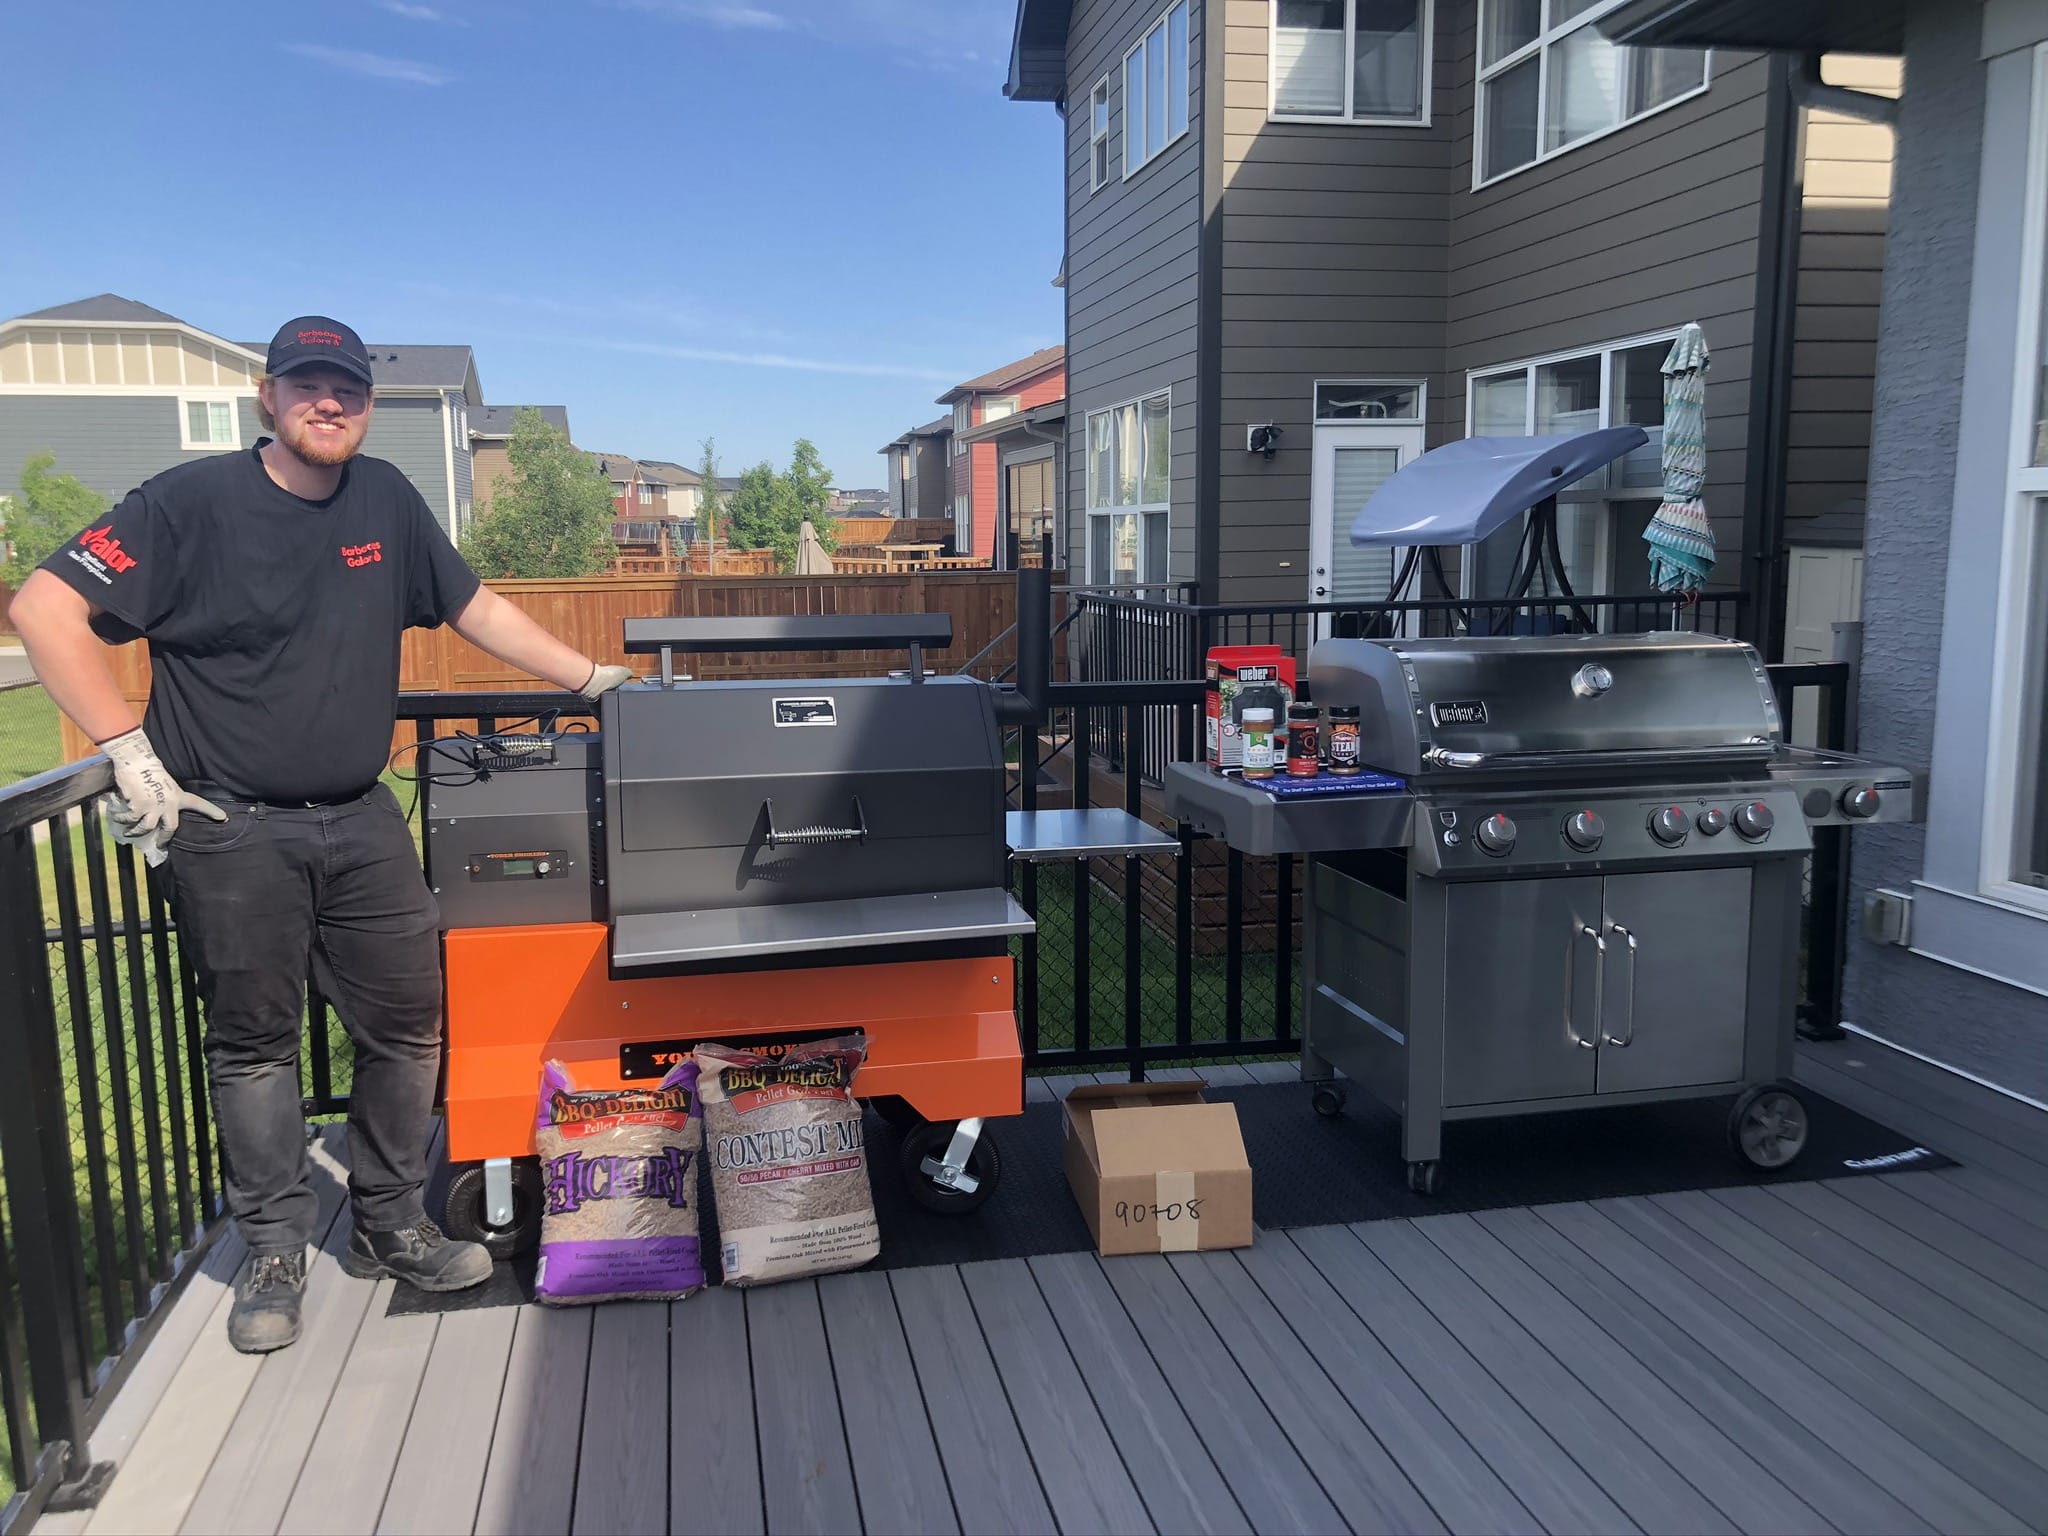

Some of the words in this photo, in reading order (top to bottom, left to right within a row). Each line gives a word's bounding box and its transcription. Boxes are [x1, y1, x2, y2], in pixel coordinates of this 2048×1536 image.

[80, 525, 137, 574] Valor
[1240, 666, 1268, 680] weber
[139, 769, 166, 806] HyFlex
[776, 1058, 844, 1089] DELIGT
[755, 1087, 783, 1104] Pellet
[584, 1121, 612, 1135] Pellet
[717, 1120, 829, 1169] CONTEST
[549, 1147, 692, 1213] HICKORY
[760, 1171, 781, 1181] PECAN
[787, 1166, 813, 1178] CHERRY
[815, 1163, 834, 1174] MIXED
[835, 1161, 849, 1170] WITH
